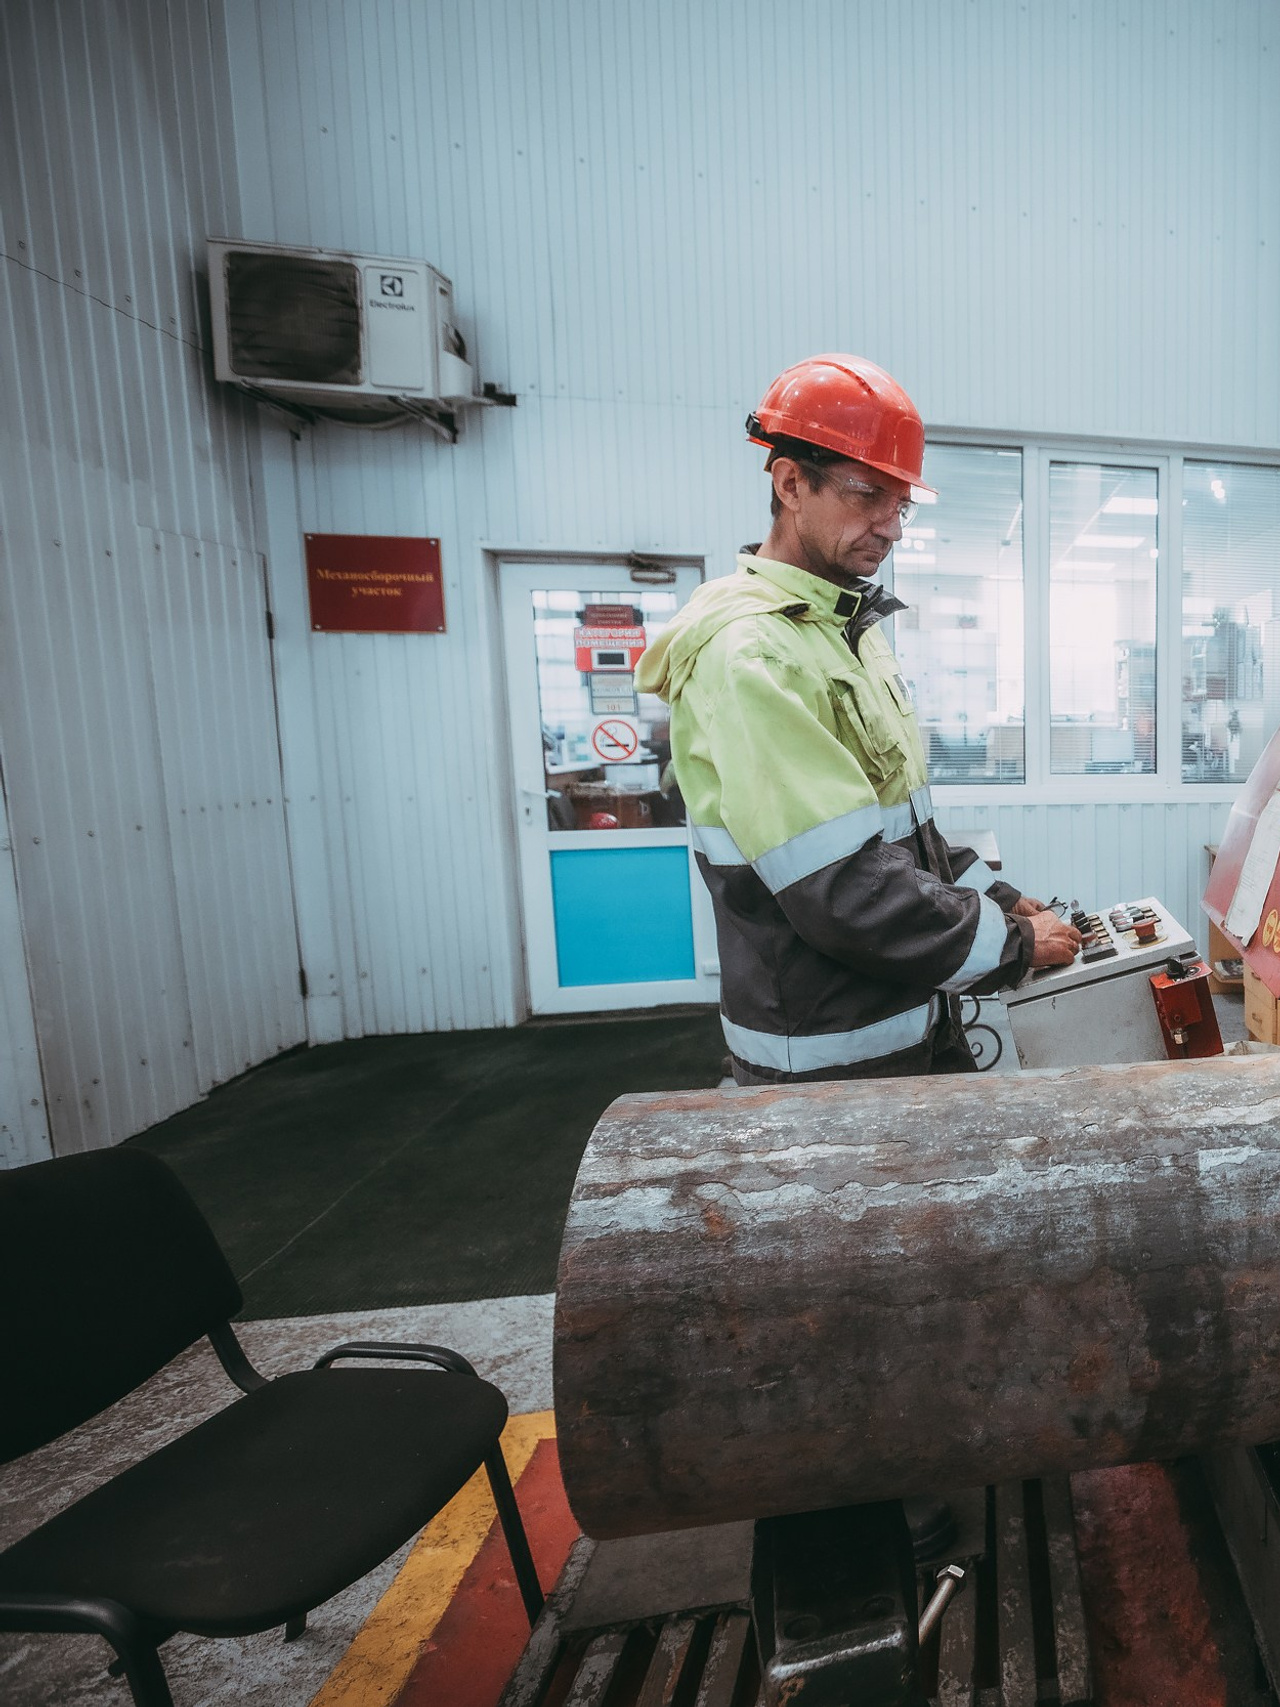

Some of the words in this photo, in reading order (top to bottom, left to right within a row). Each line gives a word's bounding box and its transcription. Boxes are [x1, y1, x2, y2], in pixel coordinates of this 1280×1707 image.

[370, 300, 415, 311] Electrolux
[316, 568, 434, 583] Механосборочный
[352, 587, 402, 597] участок
[579, 628, 641, 637] КАТЕГОРИЯ
[575, 638, 645, 648] ПОМЕЩЕНИЯ
